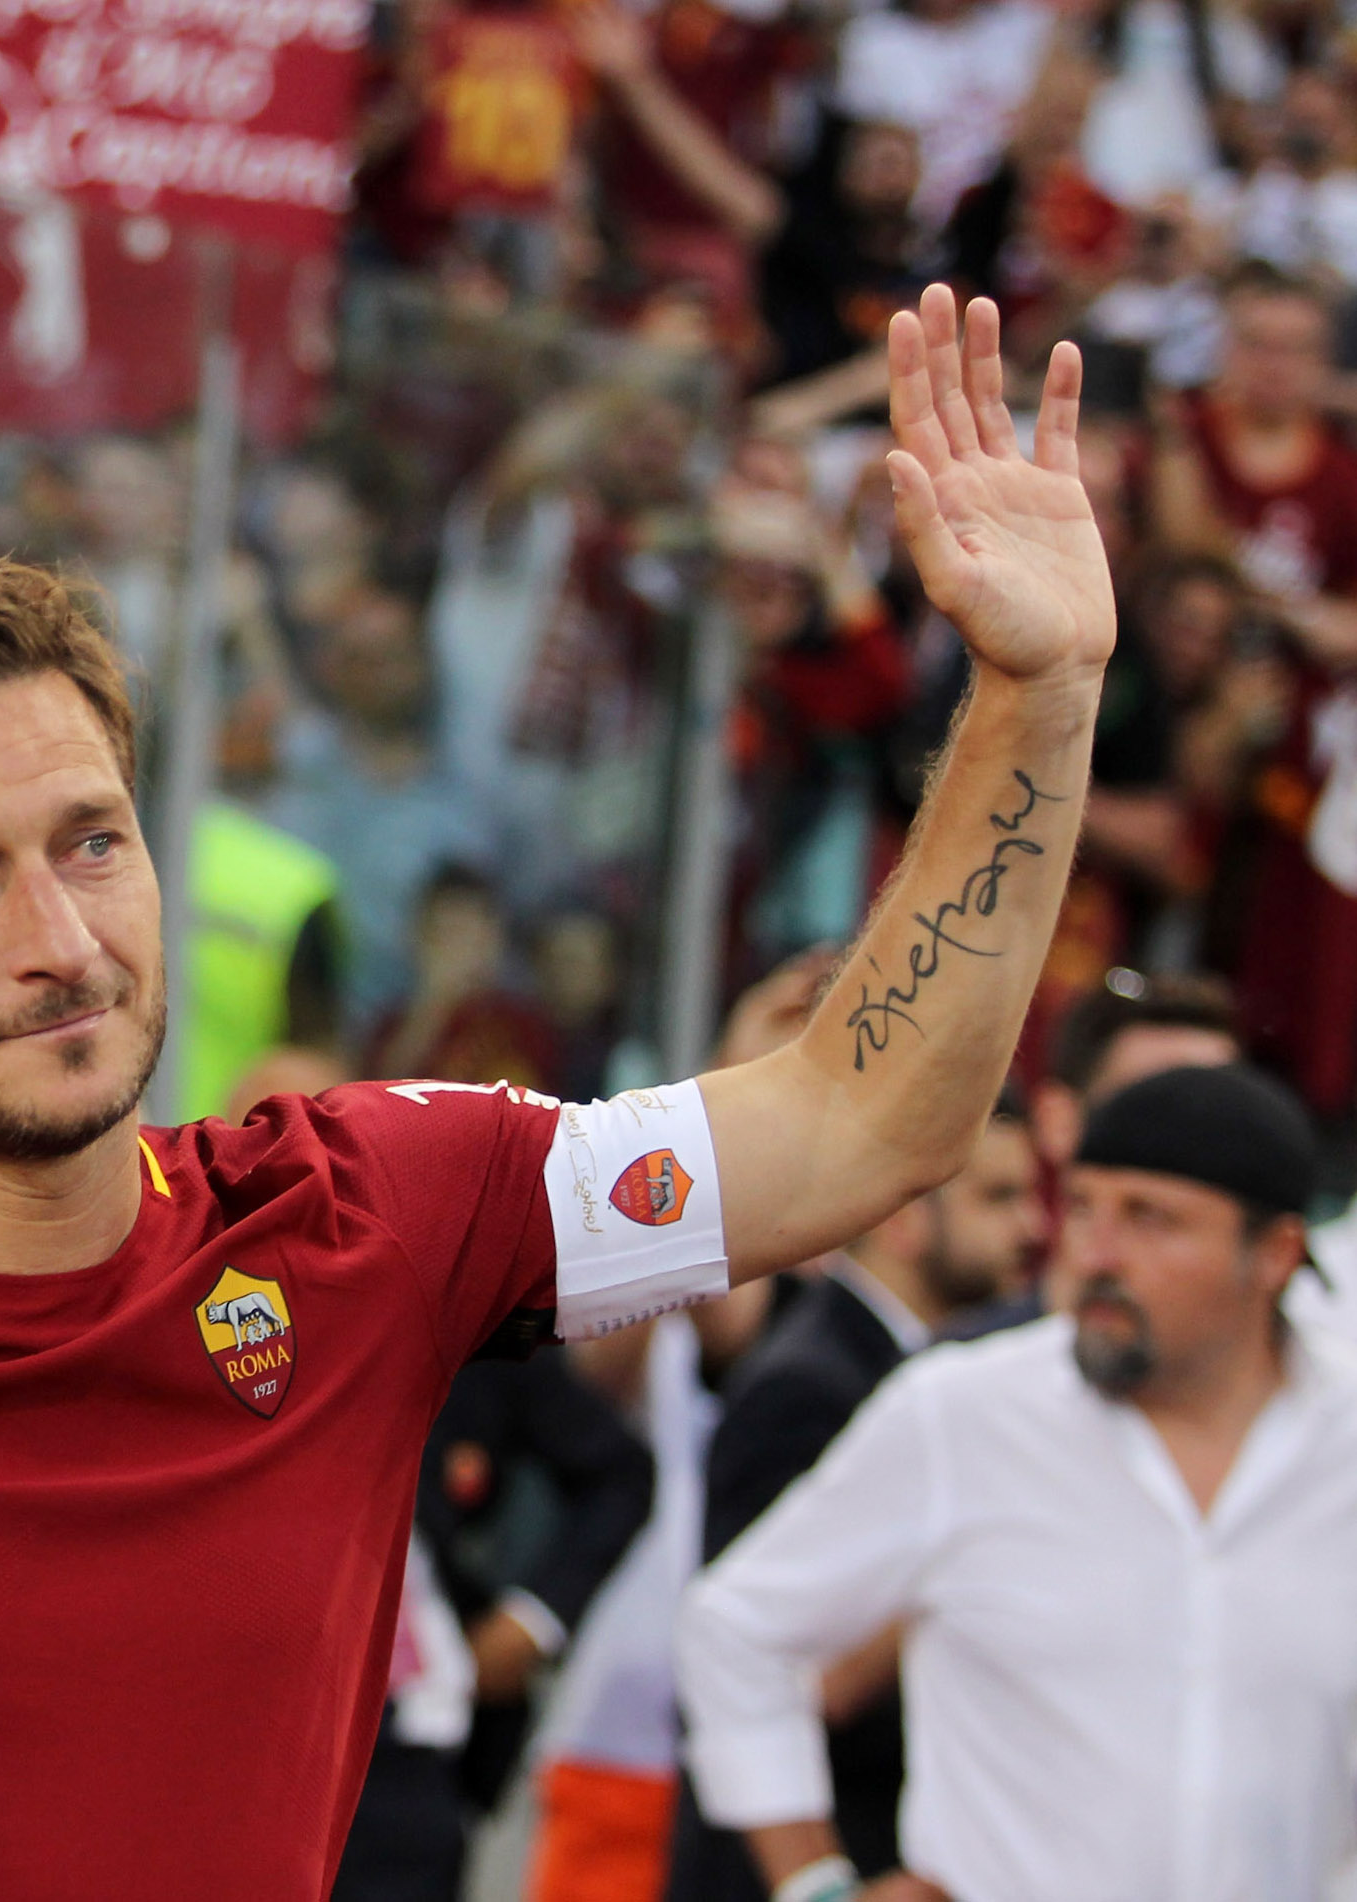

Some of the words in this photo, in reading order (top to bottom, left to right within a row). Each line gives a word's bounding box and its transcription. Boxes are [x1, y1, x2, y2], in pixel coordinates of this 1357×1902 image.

[630, 1165, 647, 1219] ROMA
[226, 1344, 292, 1383] ROMA
[253, 1380, 278, 1399] 1927
